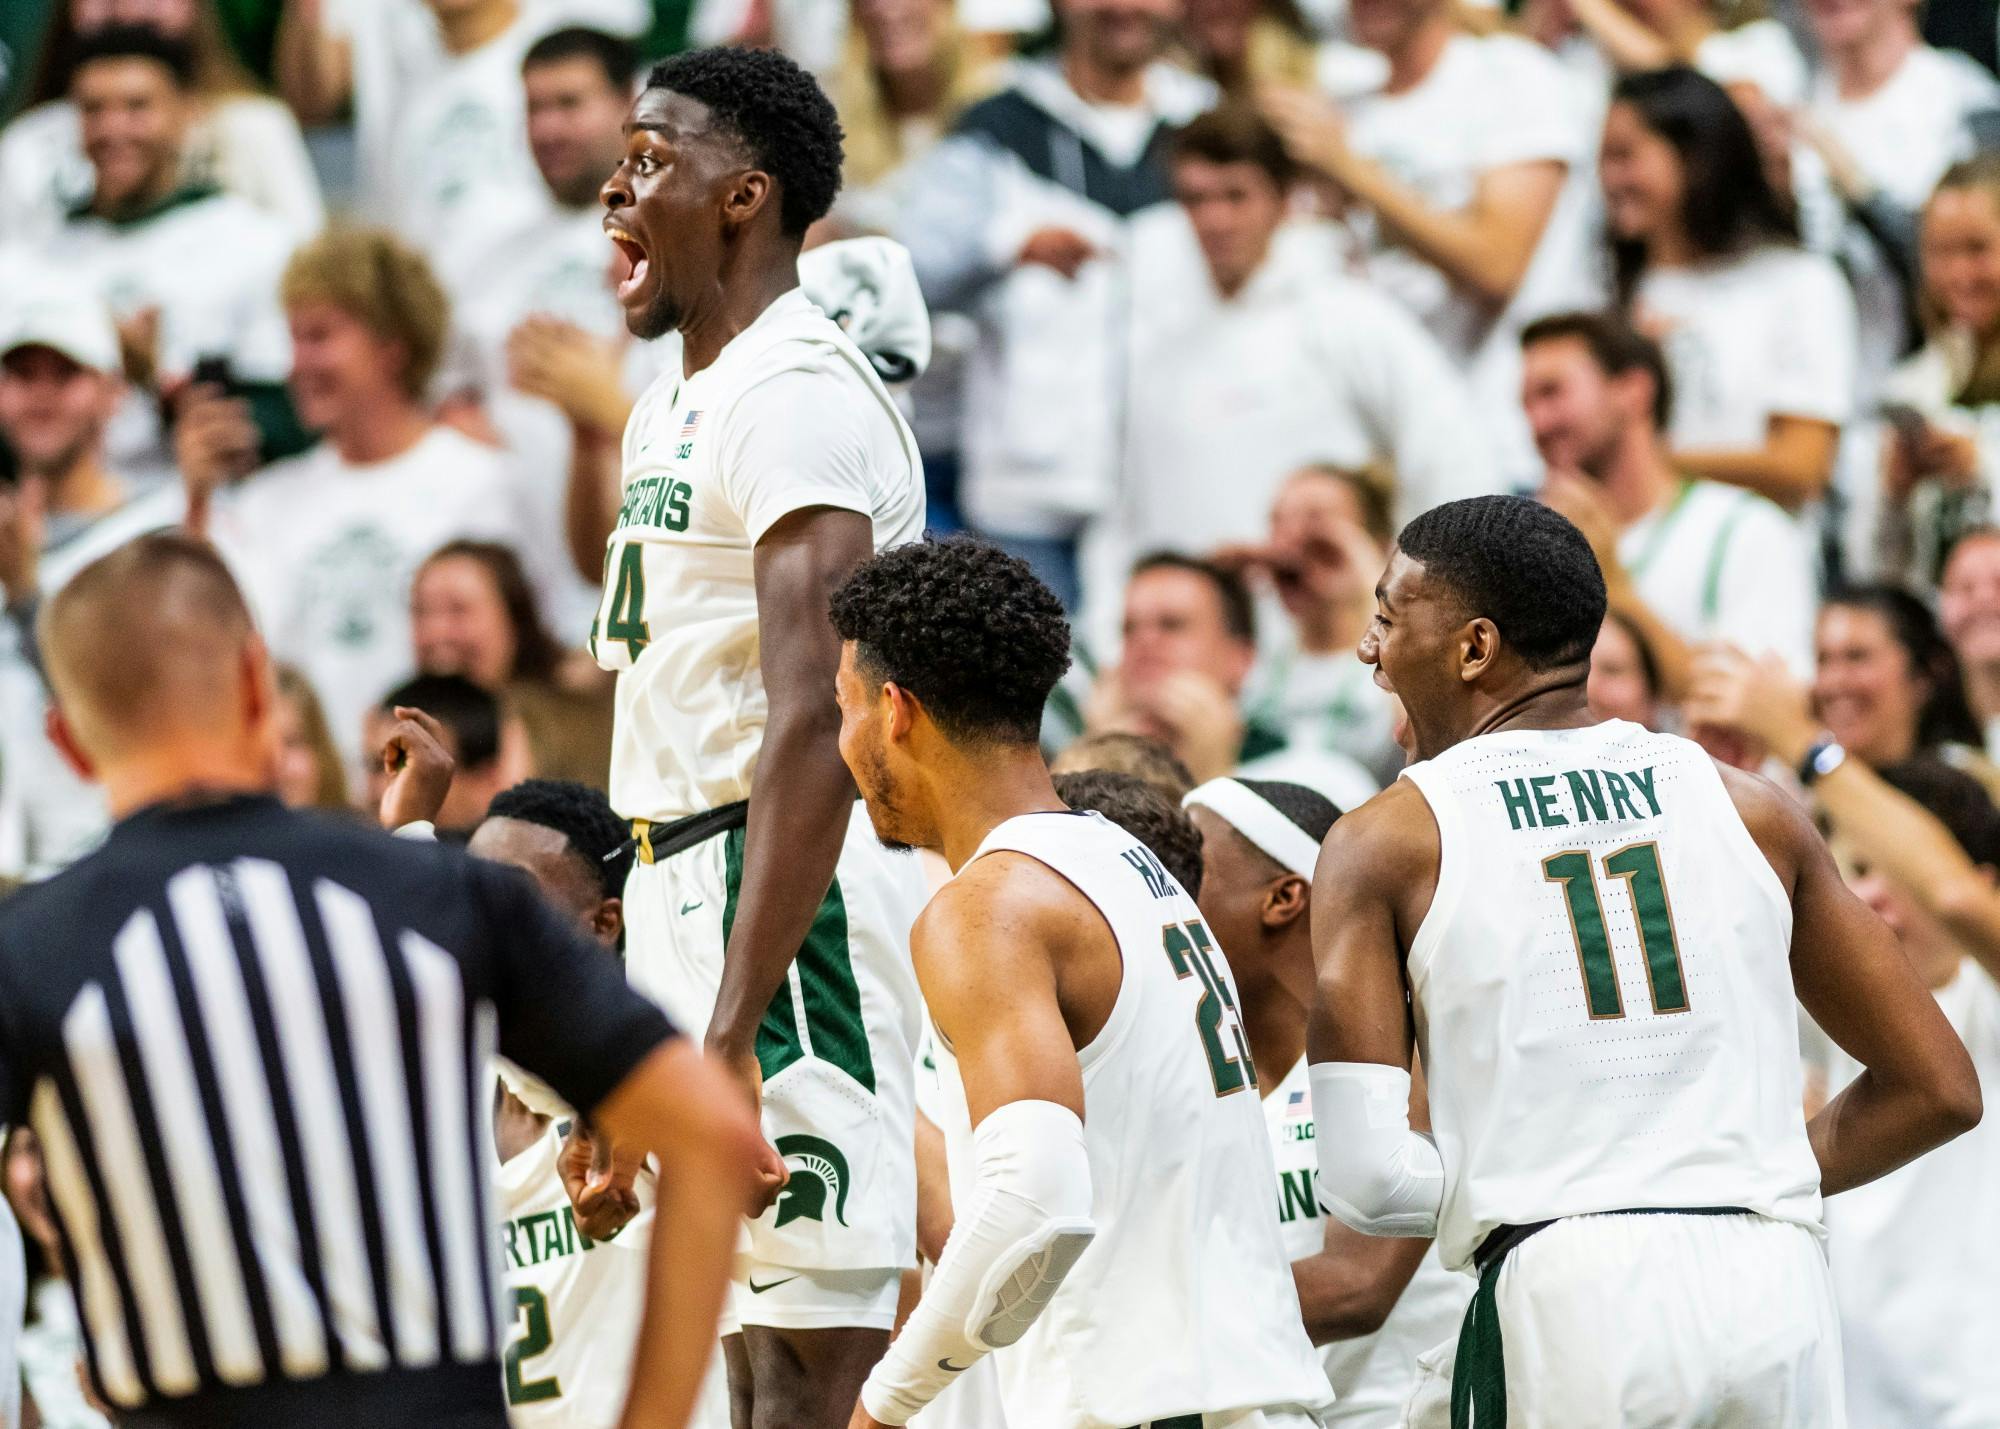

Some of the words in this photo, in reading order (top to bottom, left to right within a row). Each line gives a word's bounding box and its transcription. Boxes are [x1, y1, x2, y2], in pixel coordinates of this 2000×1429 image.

[1494, 766, 1662, 830] HENRY
[1541, 841, 1691, 1020] 11
[1162, 919, 1258, 1098] 25
[503, 1286, 561, 1405] 2
